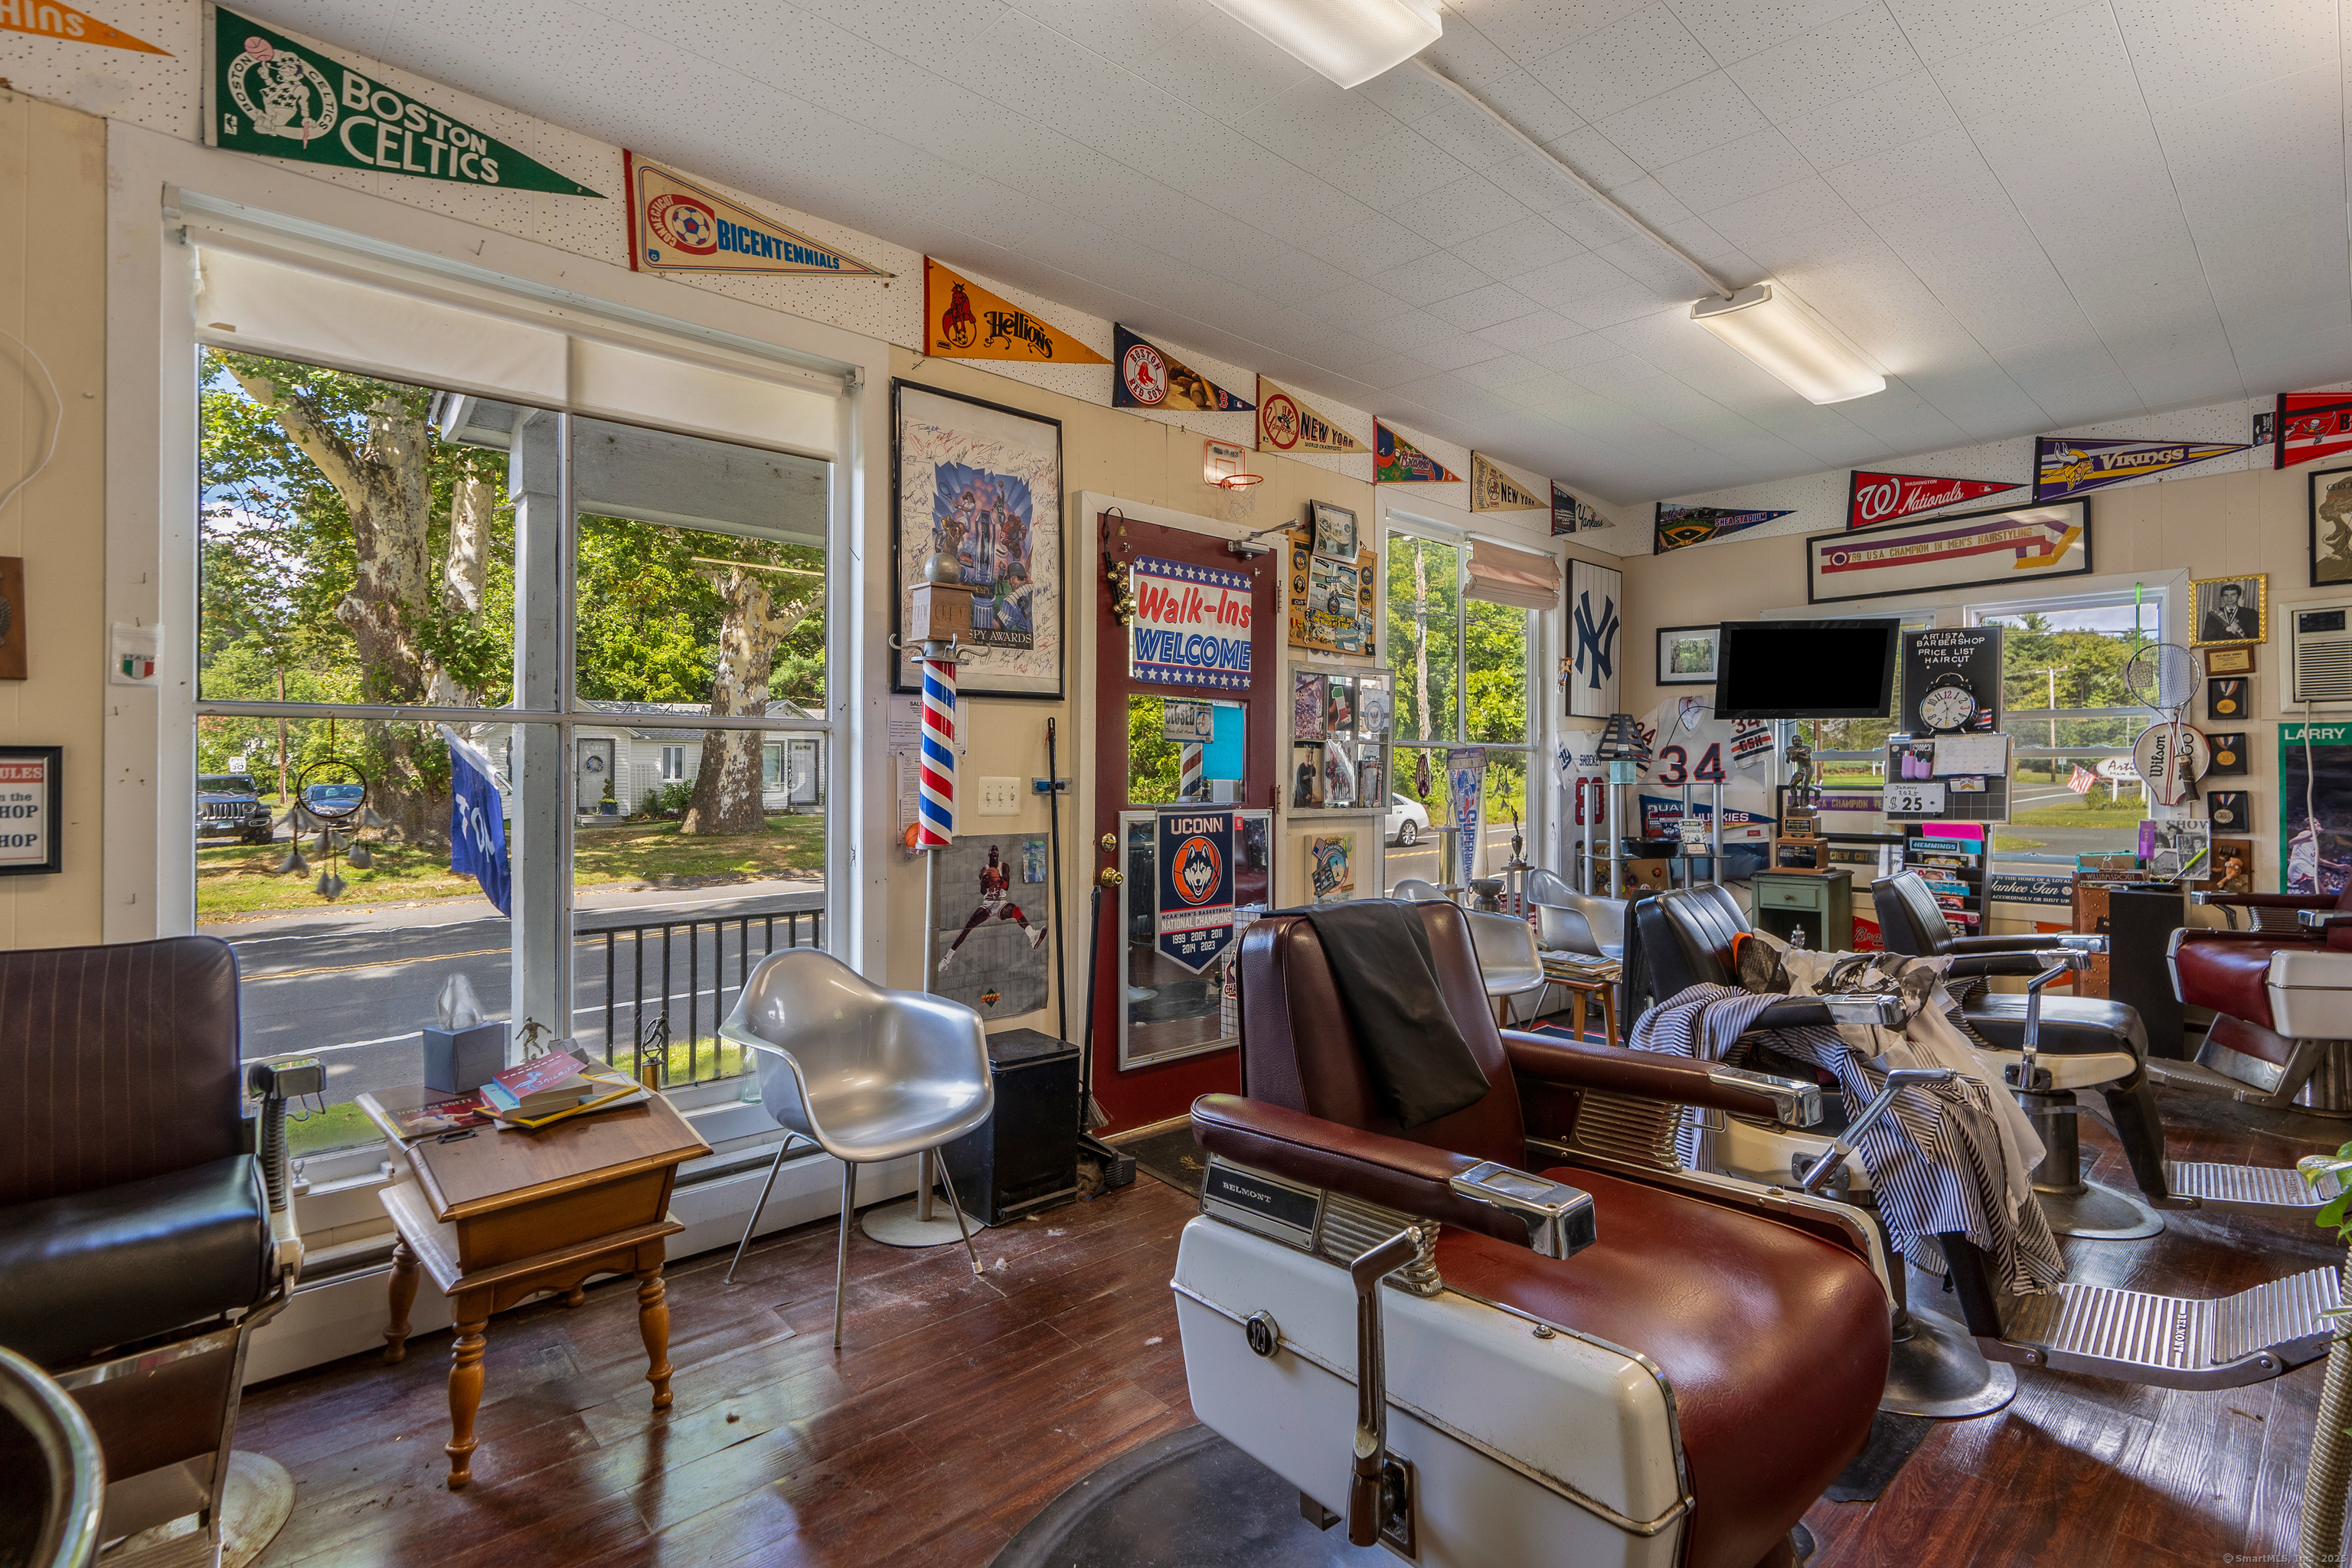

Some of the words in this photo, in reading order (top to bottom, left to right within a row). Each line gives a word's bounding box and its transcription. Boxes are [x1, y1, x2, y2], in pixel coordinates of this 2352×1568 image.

[231, 55, 254, 113] BOSTON
[309, 70, 335, 130] CELTICS
[342, 70, 487, 156] BOSTON
[340, 116, 499, 184] CELTICS
[650, 194, 678, 247] CONNECTICUT
[717, 217, 840, 270] BICENTENNIALS
[983, 310, 1054, 359] Hellions
[1129, 348, 1162, 371] BOSTON
[1129, 377, 1145, 397] RED
[1147, 384, 1163, 400] SOX
[1263, 406, 1295, 439] Yankees
[1300, 411, 1330, 443] NEW
[1331, 428, 1354, 448] YORK
[2340, 413, 2352, 433] B
[1400, 449, 1429, 470] Braves
[2099, 447, 2184, 470] VIKINGS
[1501, 482, 1519, 505] NEW
[1520, 493, 1536, 506] YORK
[1898, 481, 1965, 514] Nationals
[1576, 502, 1604, 531] Yankees
[1663, 507, 1687, 521] Mets
[1714, 517, 1734, 528] SHEA
[1735, 511, 1767, 525] STADIUM
[1867, 550, 1885, 560] USA
[1890, 543, 1929, 557] CHAMPION
[1934, 541, 1943, 550] IN
[1947, 537, 1973, 550] MEN'S
[1978, 528, 2033, 545] HAIRSTYLING
[975, 586, 991, 595] ESPY
[1138, 581, 1252, 628] Walk-Ins
[969, 629, 987, 639] SPY
[990, 632, 1032, 644] AWARDS
[1916, 637, 1985, 647] BARBERSHOP
[1922, 632, 1965, 641] ARTISTA
[1135, 626, 1252, 671] WELCOME
[1925, 655, 1970, 664] HAIRCUT
[1927, 697, 1939, 707] 10
[1934, 692, 1944, 702] 11
[1944, 691, 1952, 699] 12
[1953, 691, 1961, 700] 1
[1165, 704, 1195, 726] CLOSED
[1934, 717, 1942, 727] 7
[1952, 717, 1960, 725] 5
[2284, 727, 2347, 740] LARRY
[1739, 735, 1763, 752] GSH
[2148, 734, 2166, 778] Wilson
[0, 766, 43, 779] ULES
[1658, 742, 1726, 789] 34
[2107, 760, 2135, 772] Arti
[10, 792, 32, 802] the
[1574, 776, 1605, 826] 80
[1831, 799, 1868, 808] CHAMPION
[1902, 797, 1923, 812] 25
[0, 805, 38, 818] HOP
[1693, 812, 1749, 822] HUKIES
[1171, 817, 1223, 835] UCONN
[0, 834, 38, 848] HOP
[1913, 841, 1956, 850] HEMMINGS
[1830, 851, 1849, 861] CREW
[1854, 851, 1869, 861] CUT
[2030, 881, 2060, 895] Fan
[1198, 906, 1232, 916] BASKETBALL
[1161, 916, 1193, 932] NATIONAL
[1195, 912, 1232, 928] CHAMPIONS
[1172, 933, 1186, 944] 1999
[1191, 930, 1207, 942] 2004
[1210, 928, 1223, 939] 2011
[1853, 926, 1883, 942] Bra
[1182, 943, 1196, 954] 2014
[1200, 940, 1216, 952] 2023
[1224, 983, 1236, 995] CHA
[536, 1063, 580, 1086] JAILBIRD
[1222, 1181, 1272, 1204] BELMONT
[2174, 1312, 2187, 1354] BELMONT
